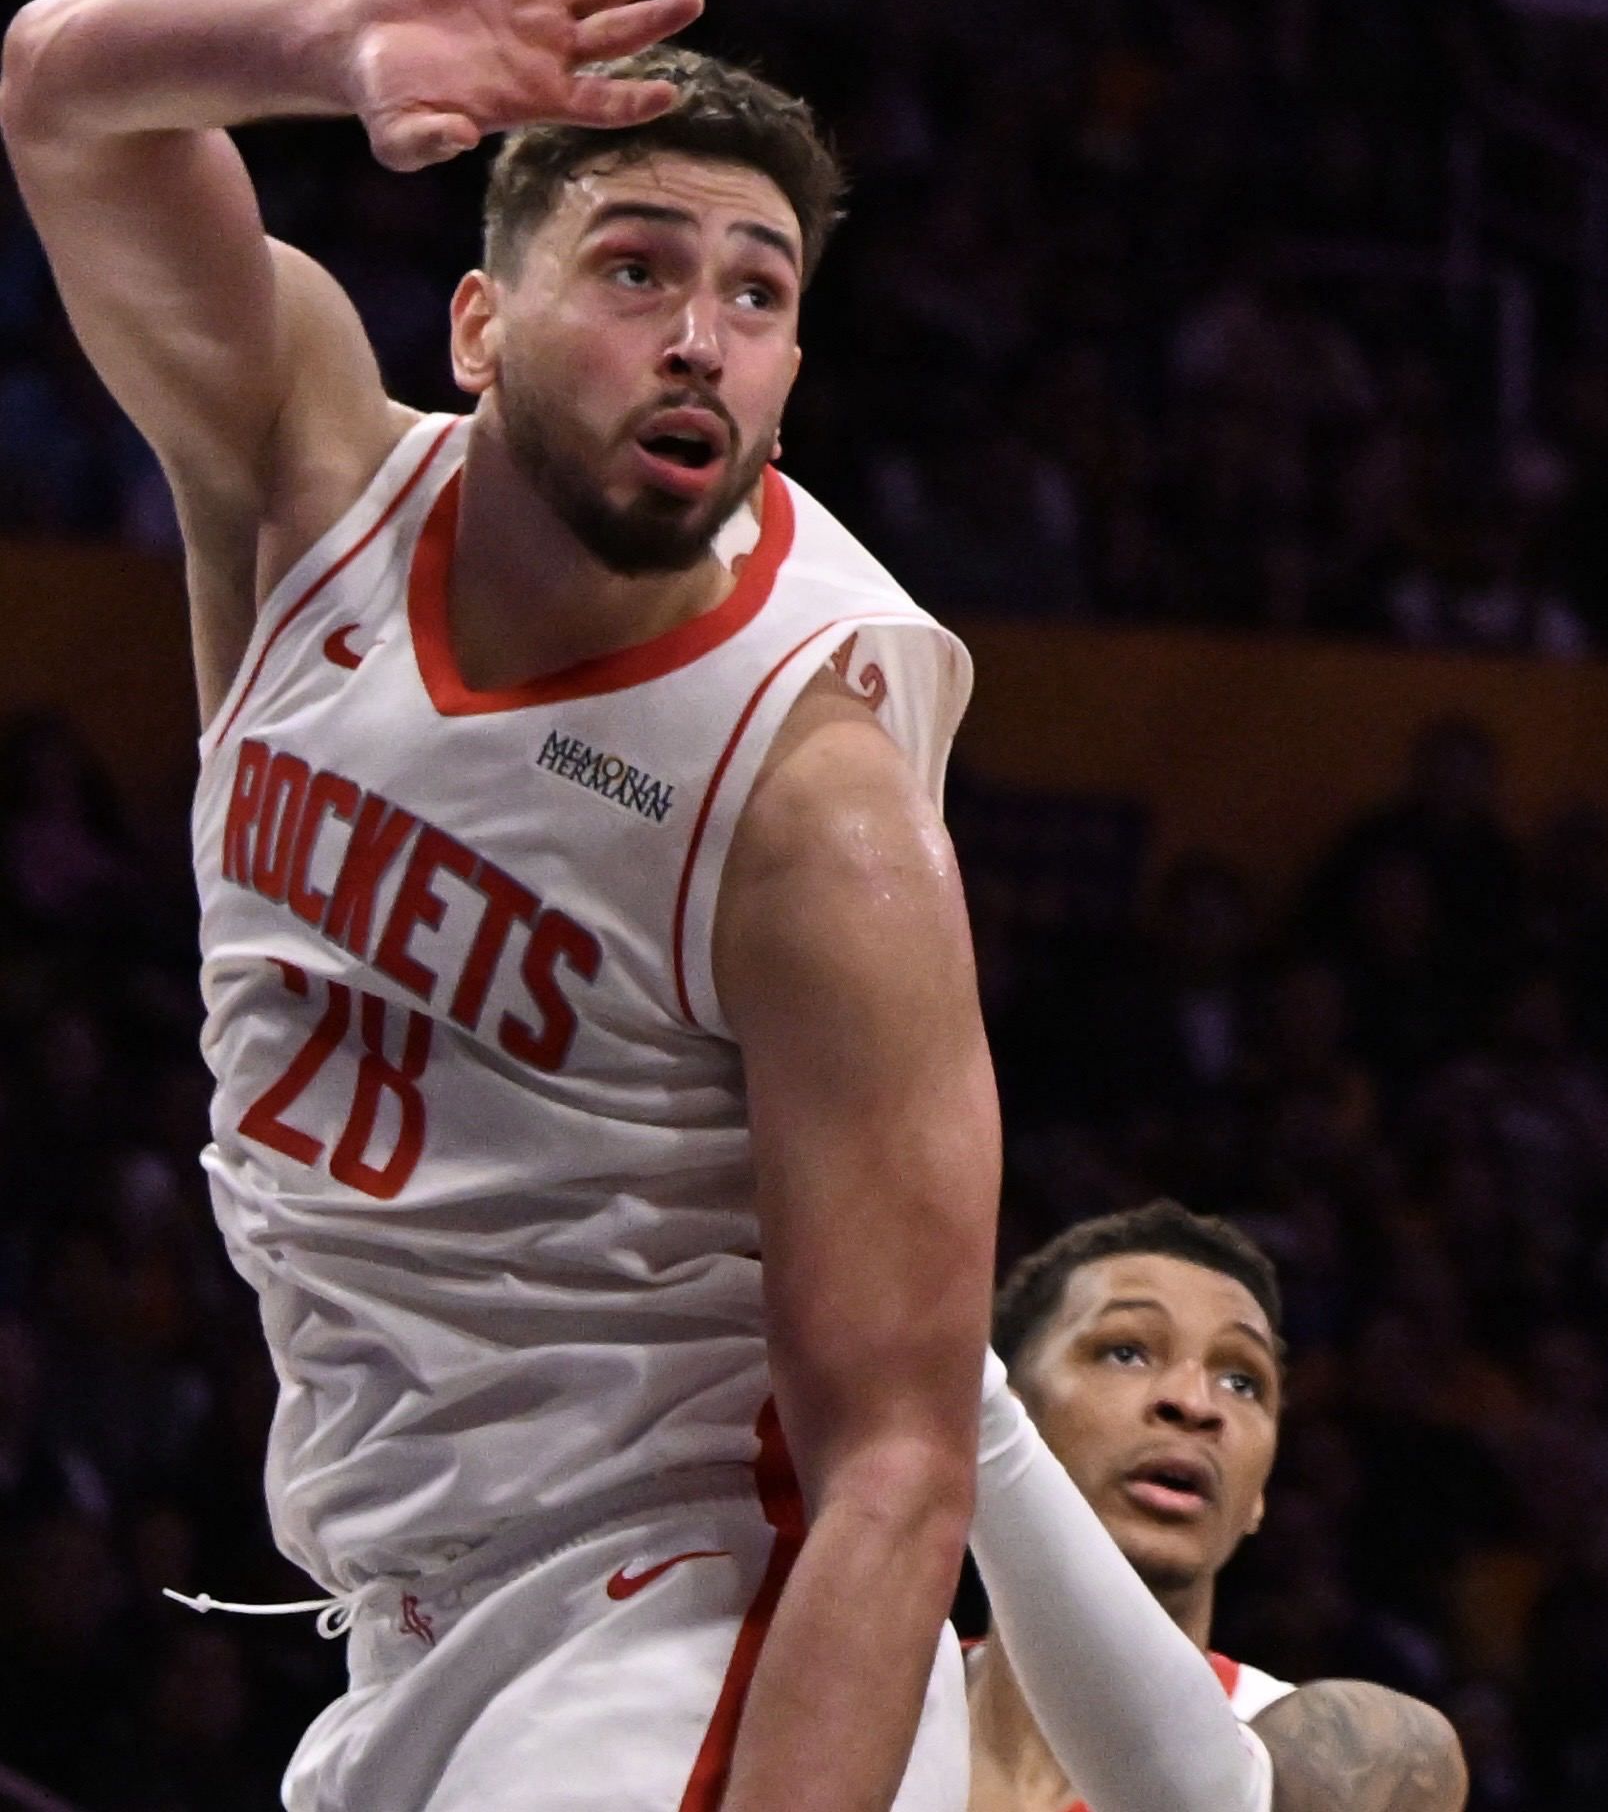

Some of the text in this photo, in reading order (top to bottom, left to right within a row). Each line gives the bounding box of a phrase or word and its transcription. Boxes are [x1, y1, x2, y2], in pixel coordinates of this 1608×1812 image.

[536, 747, 670, 823] HERMANN
[541, 729, 675, 808] MEMORIAL
[222, 737, 604, 1072] ROCKETS
[237, 957, 436, 1201] 28
